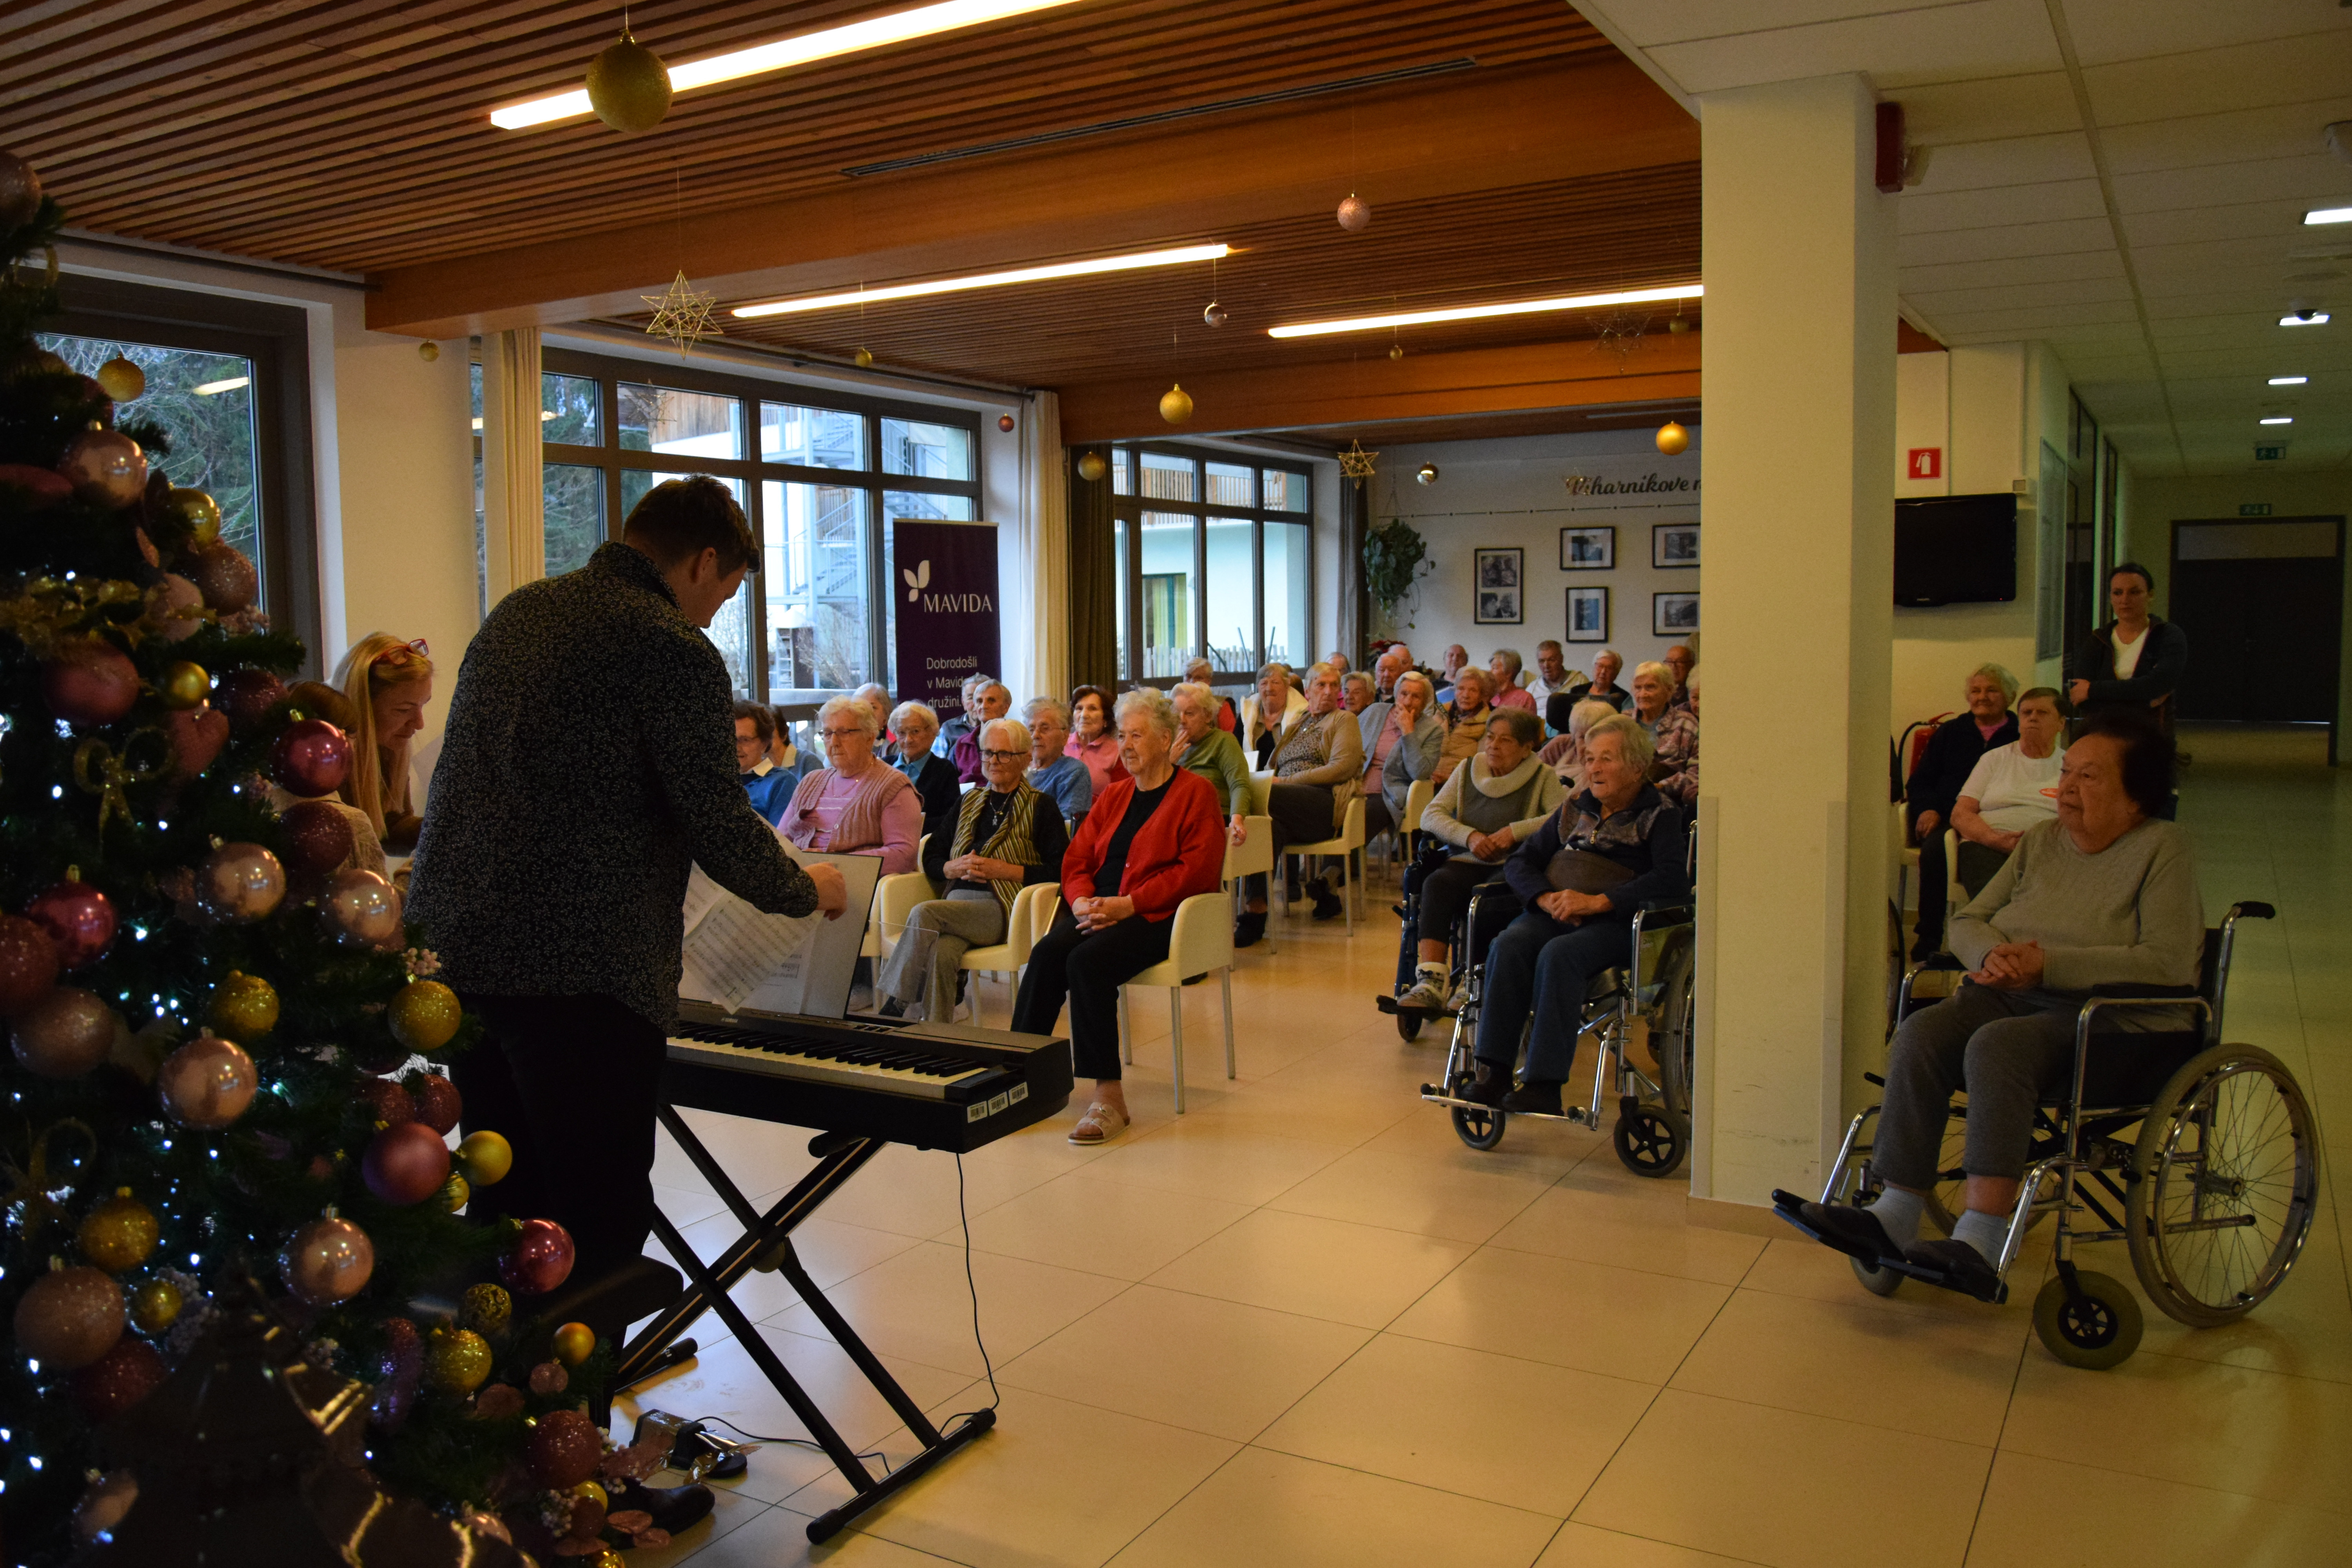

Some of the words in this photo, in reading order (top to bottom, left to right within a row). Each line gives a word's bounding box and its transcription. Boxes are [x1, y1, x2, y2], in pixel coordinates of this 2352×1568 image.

[924, 593, 992, 612] MAVIDA
[927, 656, 977, 669] Dobrodošli
[927, 680, 933, 689] v
[936, 676, 963, 688] Mavid
[927, 696, 961, 708] družini.
